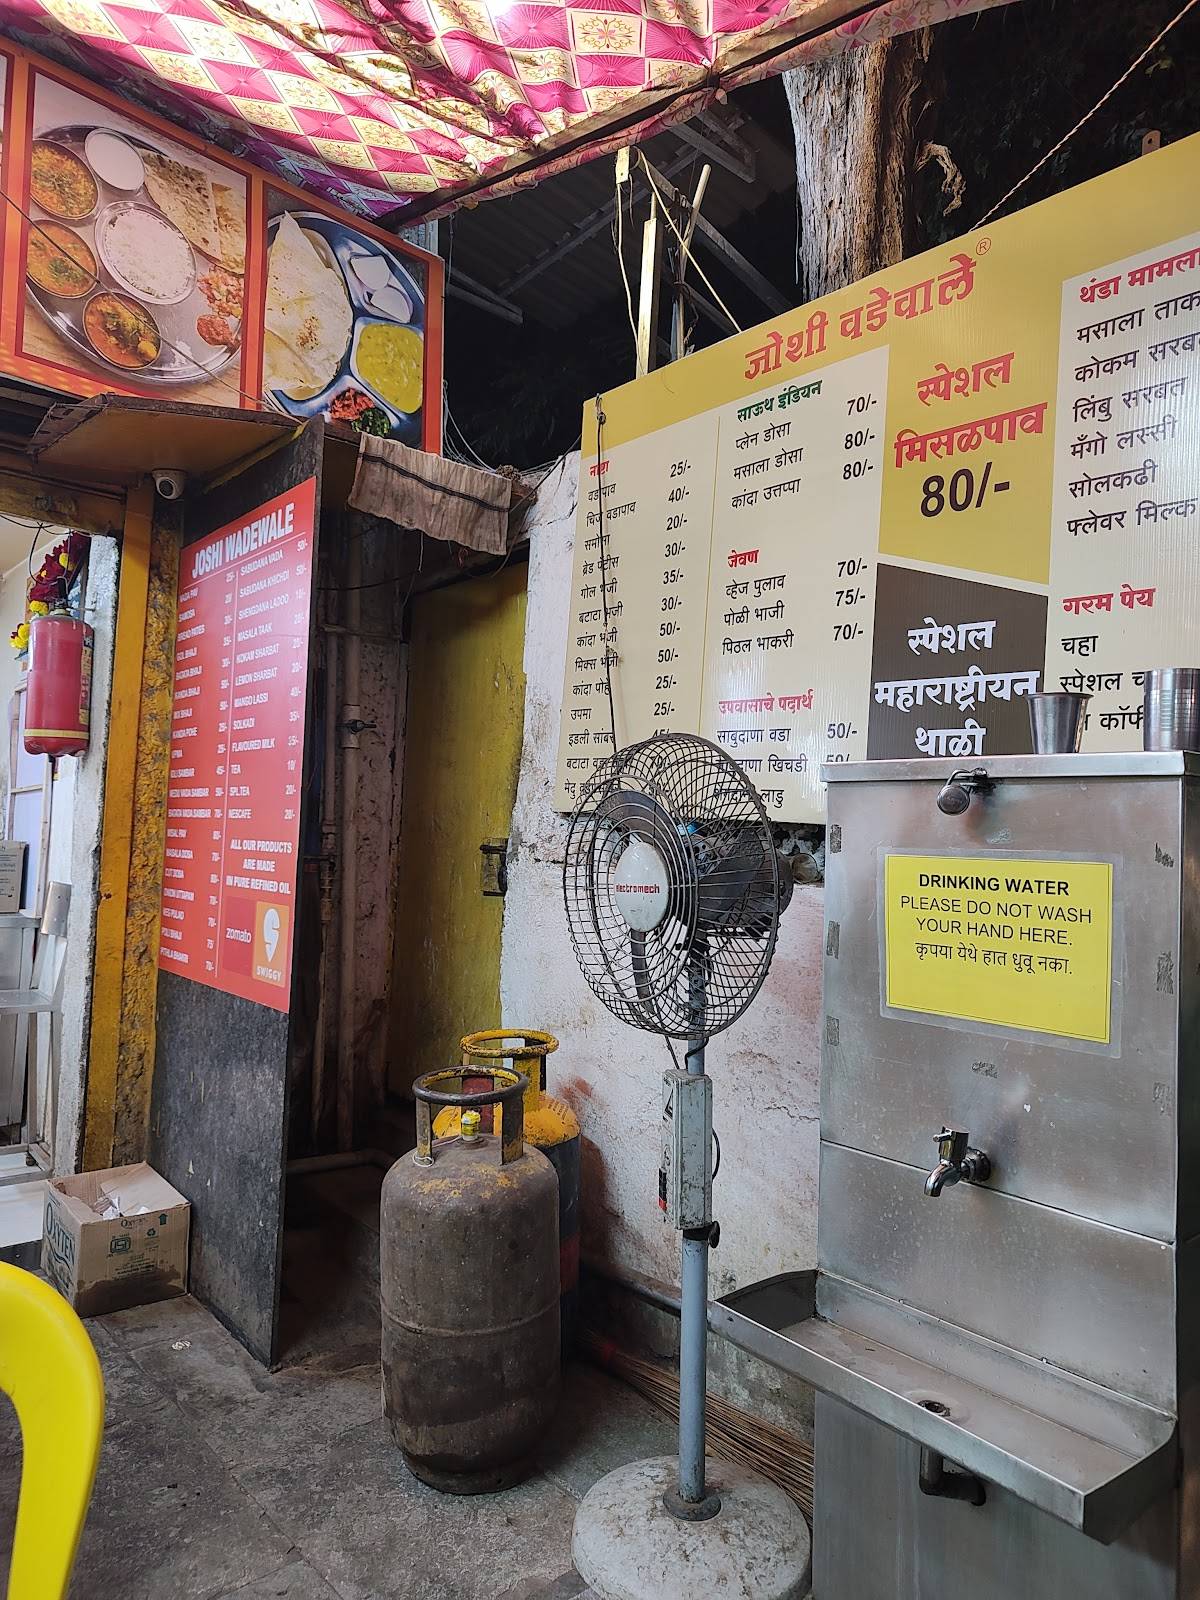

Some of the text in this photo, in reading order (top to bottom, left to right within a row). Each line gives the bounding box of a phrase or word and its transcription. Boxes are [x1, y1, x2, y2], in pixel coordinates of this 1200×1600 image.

[1080, 278, 1121, 302] थंडा
[745, 311, 828, 379] जोशी
[840, 253, 976, 340] वडेवाले
[1077, 309, 1145, 343] मसाला
[1074, 332, 1200, 382] कोकम सरब
[917, 352, 1015, 406] स्पेशल
[737, 380, 822, 422] साऊथ इंडियन
[1073, 376, 1188, 422] लिंबु सरबत
[736, 393, 877, 450] प्लेन डोसा 70/-
[894, 402, 1048, 468] मिसळपाव
[1117, 414, 1177, 449] लस्सी
[734, 428, 875, 480] मसाला डोसा 80/-
[670, 460, 691, 478] 25/-
[1069, 459, 1158, 498] सोलकढी
[731, 459, 873, 509] कांदा उत्तप्पा 80/-
[921, 462, 1010, 517] 80/-
[606, 502, 636, 520] वडापाव
[668, 486, 689, 503] 40/-
[1067, 498, 1199, 536] फ्लेवर मिल्क
[666, 513, 688, 531] 20/-
[192, 503, 294, 578] JOSHI WADEWALE
[664, 541, 686, 558] 30/-
[728, 550, 759, 568] जेवण
[580, 584, 596, 599] गोल
[663, 568, 684, 585] 35/-
[726, 558, 868, 599] व्हेज पुलाव 70/-
[578, 609, 601, 624] बटाटा
[661, 595, 682, 612] 30/-
[724, 588, 866, 626] पोळी भाजी 75/-
[1063, 584, 1156, 615] गरम पेय
[577, 631, 596, 647] कांदा
[659, 621, 681, 637] 50/-
[722, 623, 863, 655] पिठल भाकरी 70/-
[908, 617, 996, 655] स्पेशल
[1061, 636, 1098, 656] चहा
[575, 656, 597, 672] मिक्स
[657, 648, 679, 663] 50/-
[572, 680, 592, 696] कांदा
[655, 674, 677, 689] 25/-
[874, 665, 1040, 712] महाराष्ट्रीयन
[1059, 668, 1123, 692] स्पेशल
[571, 701, 675, 720] उपमा 25/-
[719, 689, 814, 714] उपवासाचे पदार्थ
[1100, 706, 1144, 731] कॉफ
[568, 728, 590, 747] इडली
[717, 722, 857, 747] साबुदाणा वडा 50/-
[915, 718, 986, 756] थाळी
[229, 763, 241, 774] TEA
[566, 757, 590, 769] बटाटा
[768, 754, 808, 773] खिचडी
[230, 838, 292, 853] ALL OUR PRODUCTS
[242, 858, 275, 872] ARE MADE
[225, 875, 291, 894] IN PURE REFINED OIL
[919, 874, 1069, 896] DRINKING WATER
[901, 896, 1092, 923] PLEASE DO NOT WASH
[225, 925, 251, 944] zomato
[916, 917, 1072, 945] YOUR HAND HERE.
[256, 963, 281, 982] SWIGGY
[915, 942, 1072, 975] कृपया येथे हात धुवू नका.
